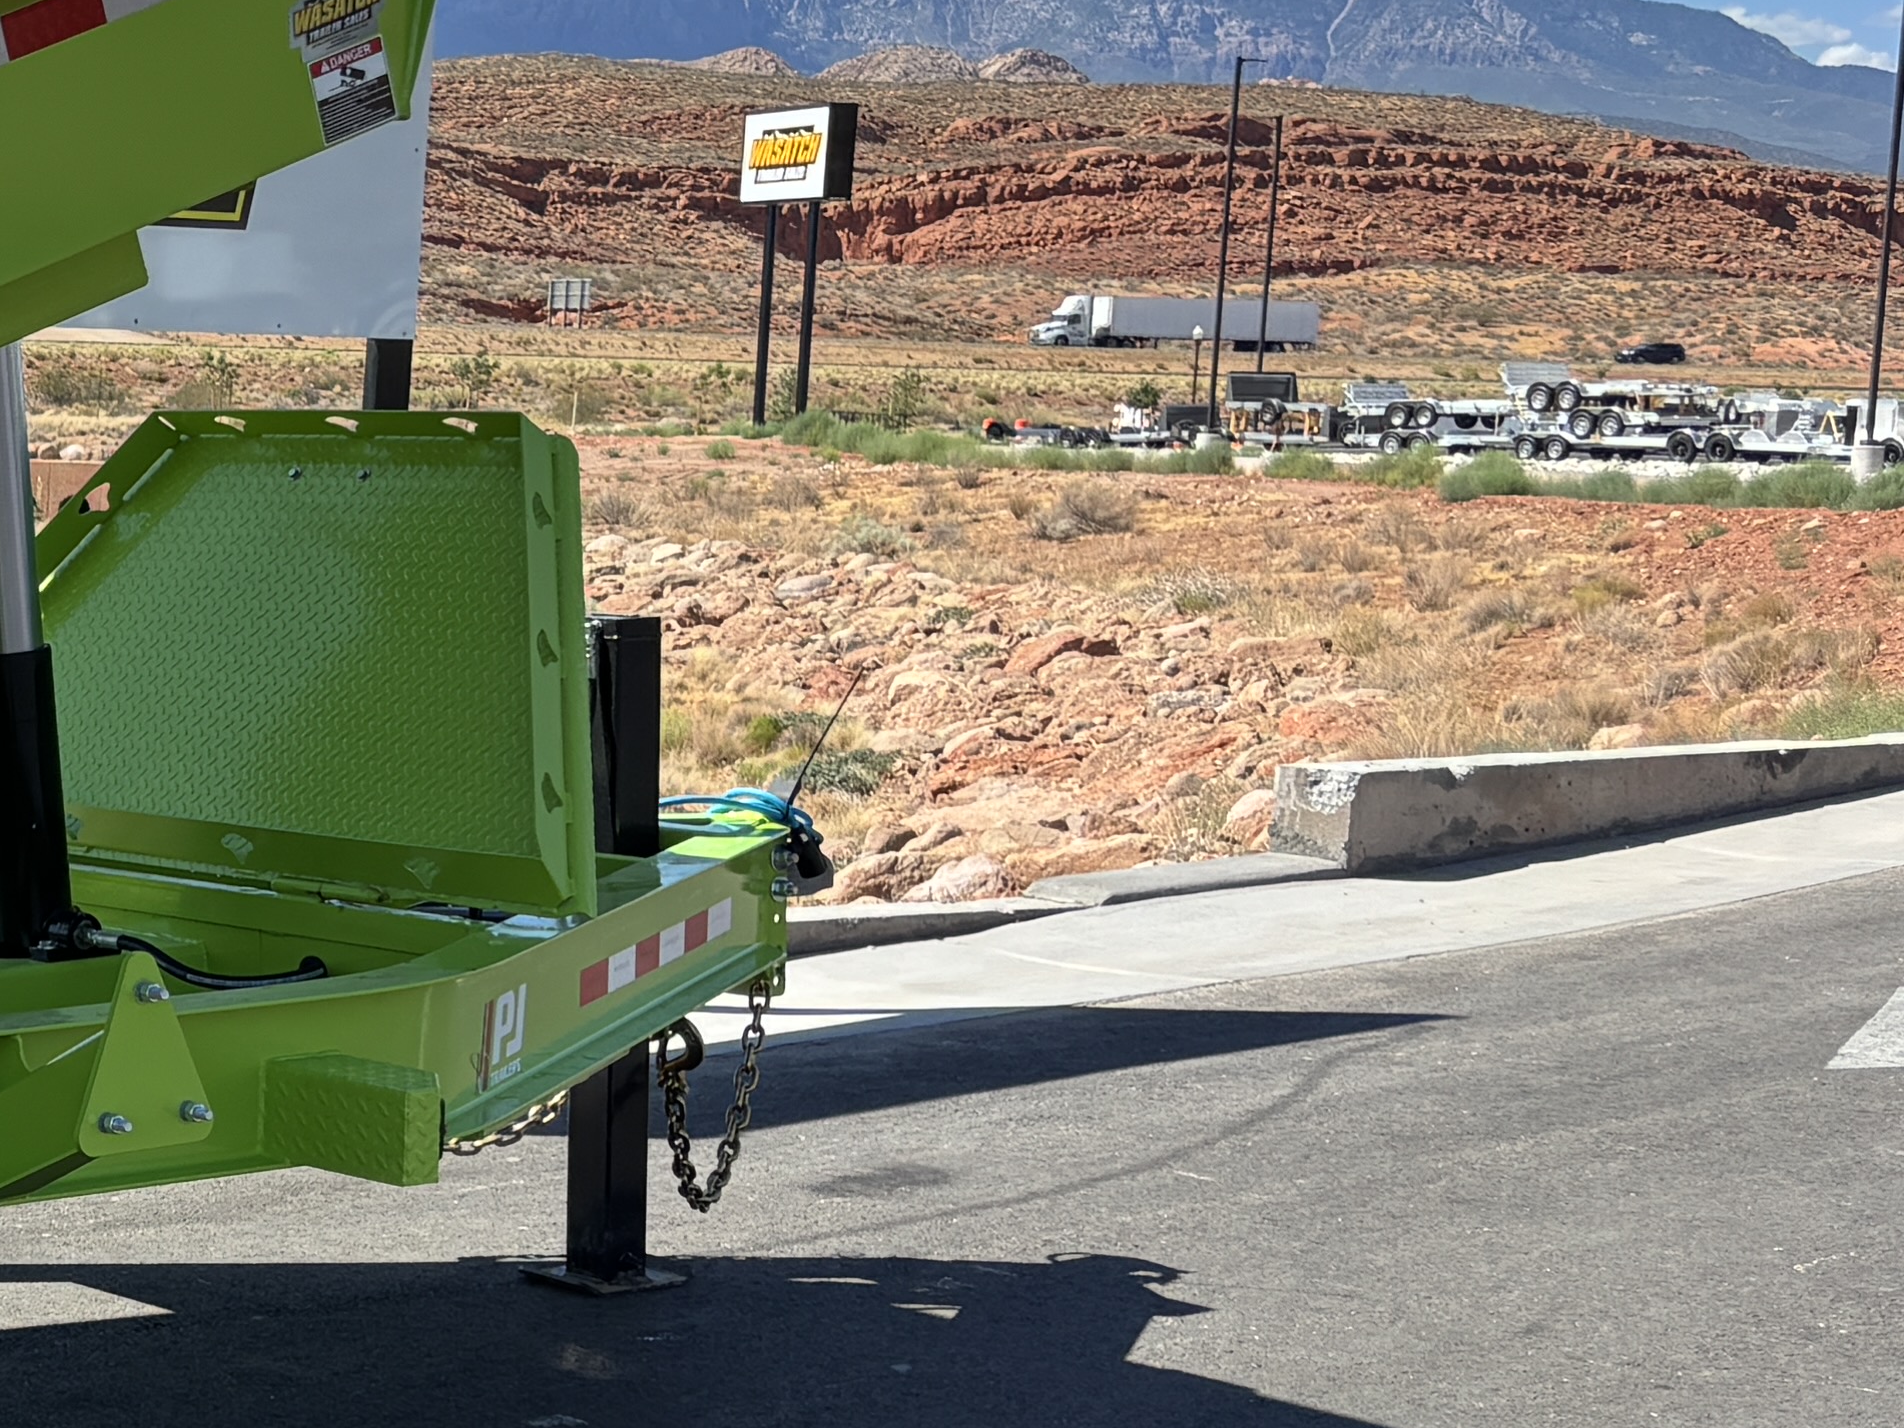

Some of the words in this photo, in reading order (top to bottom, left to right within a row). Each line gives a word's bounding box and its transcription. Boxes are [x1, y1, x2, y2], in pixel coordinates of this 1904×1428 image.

[329, 43, 372, 69] DANGER
[749, 133, 822, 169] WASATCH
[492, 982, 527, 1065] PJ
